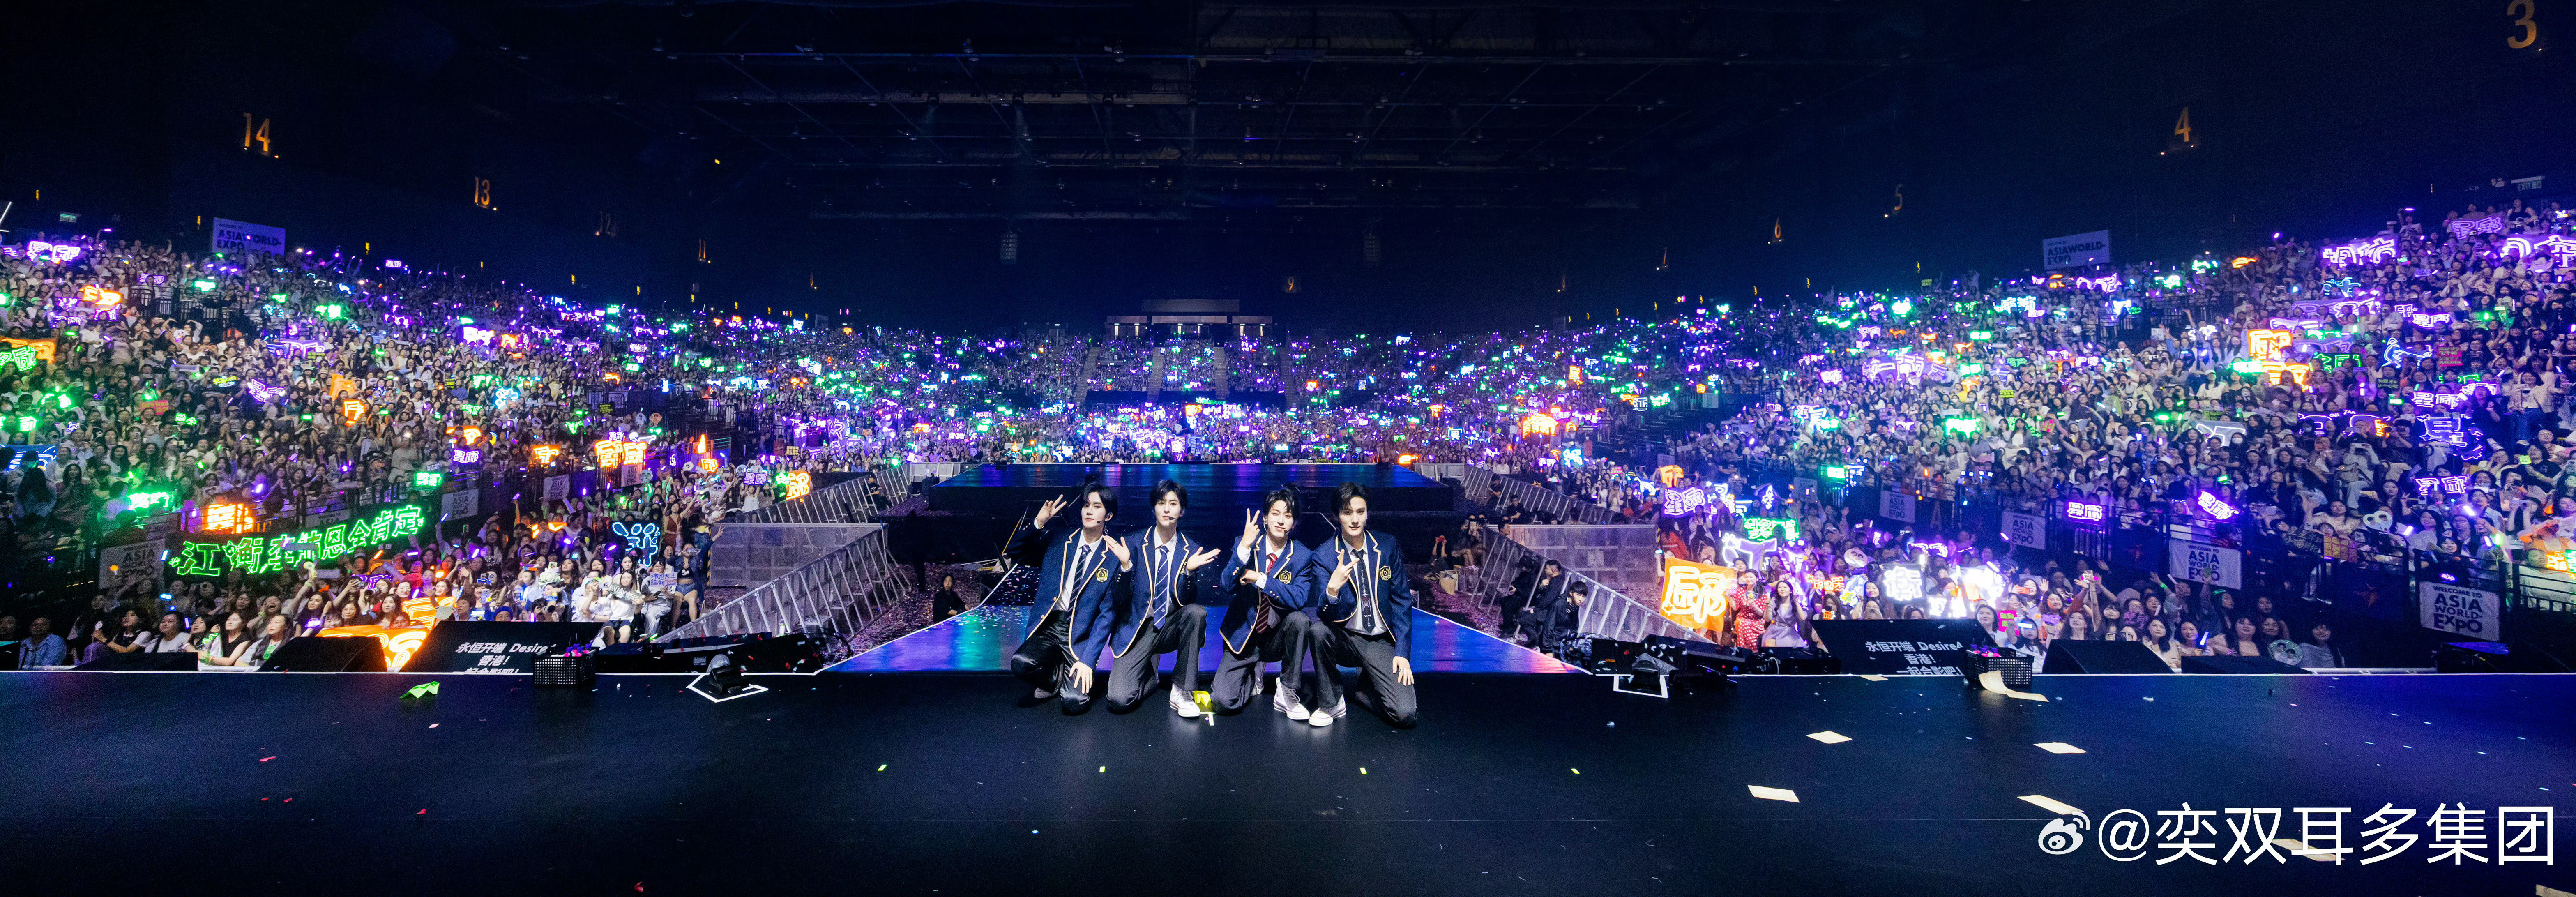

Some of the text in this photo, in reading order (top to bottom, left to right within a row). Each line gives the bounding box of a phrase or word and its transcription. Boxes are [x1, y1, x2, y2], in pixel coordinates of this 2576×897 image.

[2507, 0, 2537, 49] 3
[2174, 106, 2191, 142] 4
[243, 112, 271, 152] 14
[475, 177, 491, 205] 13
[1894, 184, 1903, 210] 5
[1774, 217, 1781, 238] 6
[217, 239, 245, 251] EXPO
[2047, 241, 2105, 256] ASIAWORLD-
[1288, 276, 1294, 291] 9
[744, 472, 767, 485] 星邱
[1664, 487, 1706, 516] 星邱
[2013, 519, 2034, 531] ASIA
[2012, 533, 2034, 544] EXPO
[2189, 551, 2219, 565] ASIA
[2188, 567, 2220, 581] EXO
[2433, 586, 2470, 597] WELCOME
[2434, 593, 2483, 614] ASIA
[2434, 604, 2483, 620] WORLD-
[2433, 613, 2483, 634] EXPO
[455, 642, 507, 654] 永恒开端
[1865, 641, 1916, 652] 永恒开端
[477, 655, 511, 666] 香港!
[1903, 653, 1937, 664] 香港!
[1896, 666, 1964, 675] 一起合影吧!
